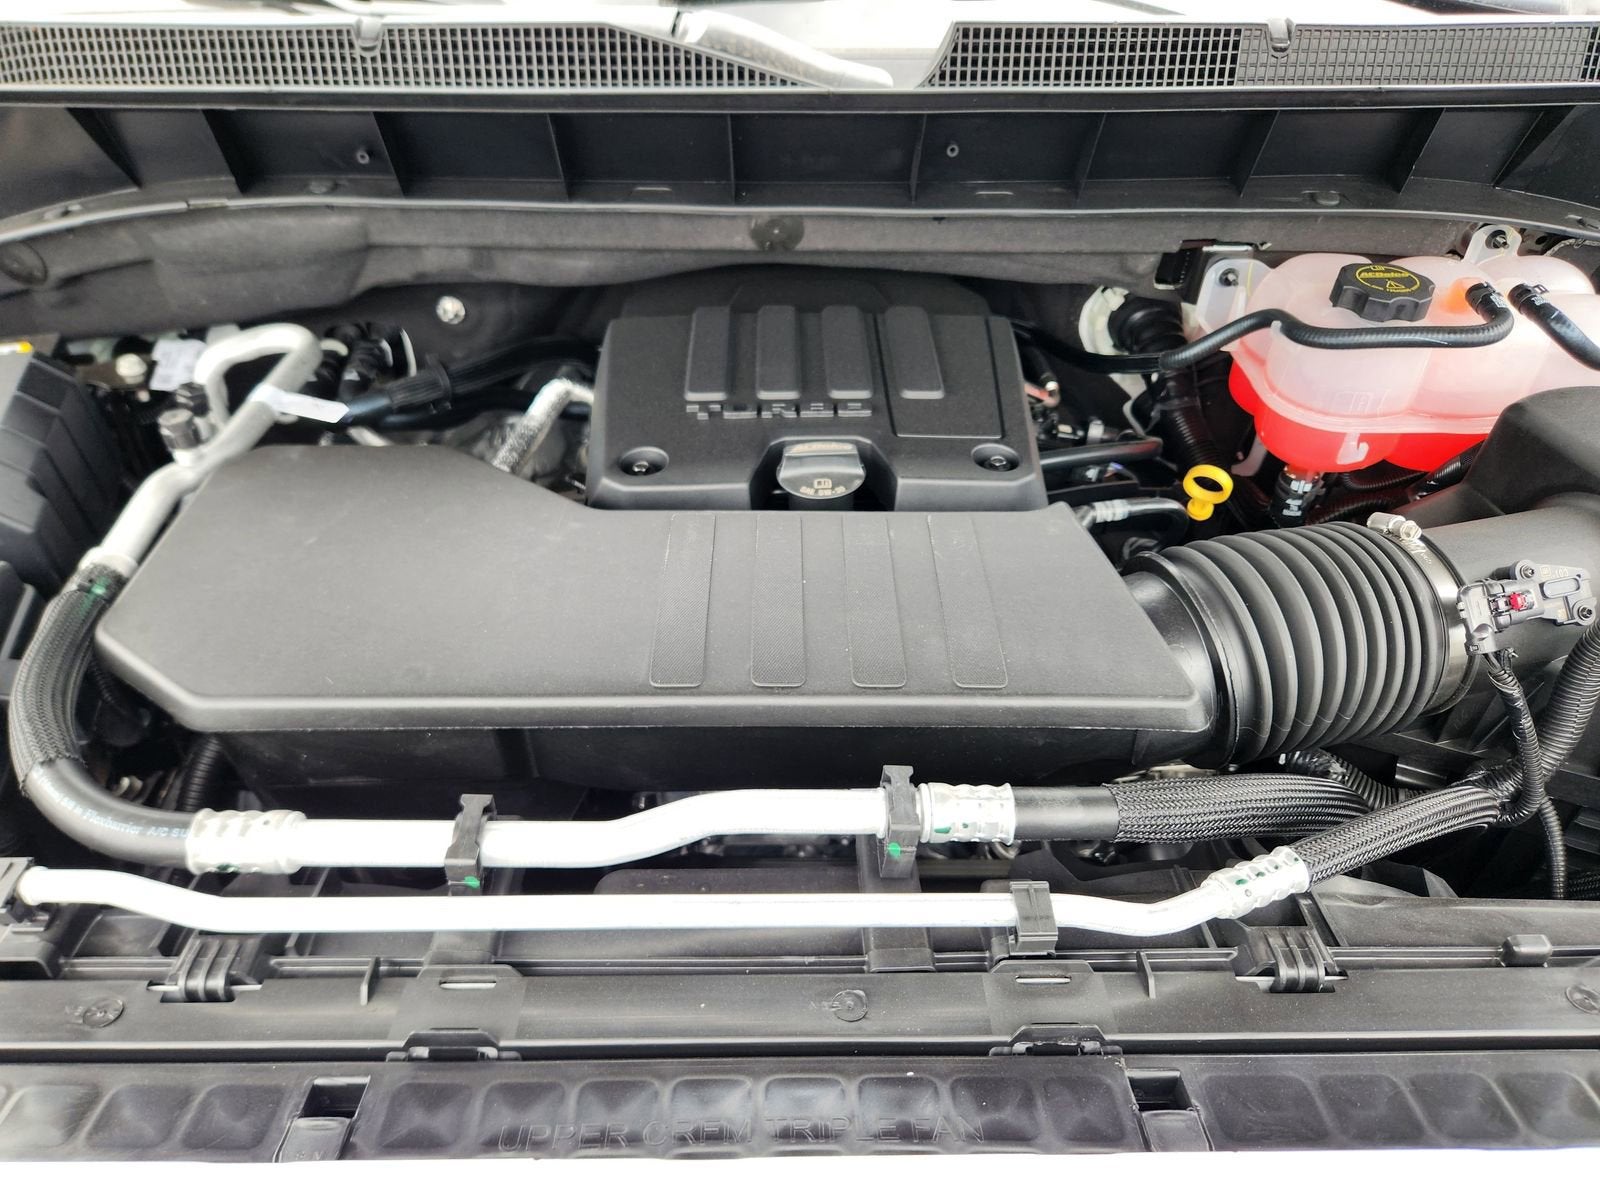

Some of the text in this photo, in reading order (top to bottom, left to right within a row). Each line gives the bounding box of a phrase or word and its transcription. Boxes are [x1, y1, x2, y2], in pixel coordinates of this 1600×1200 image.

[1360, 271, 1409, 279] ACDelco
[497, 1115, 986, 1152] UPPER CRFM TRIPLE FAN
